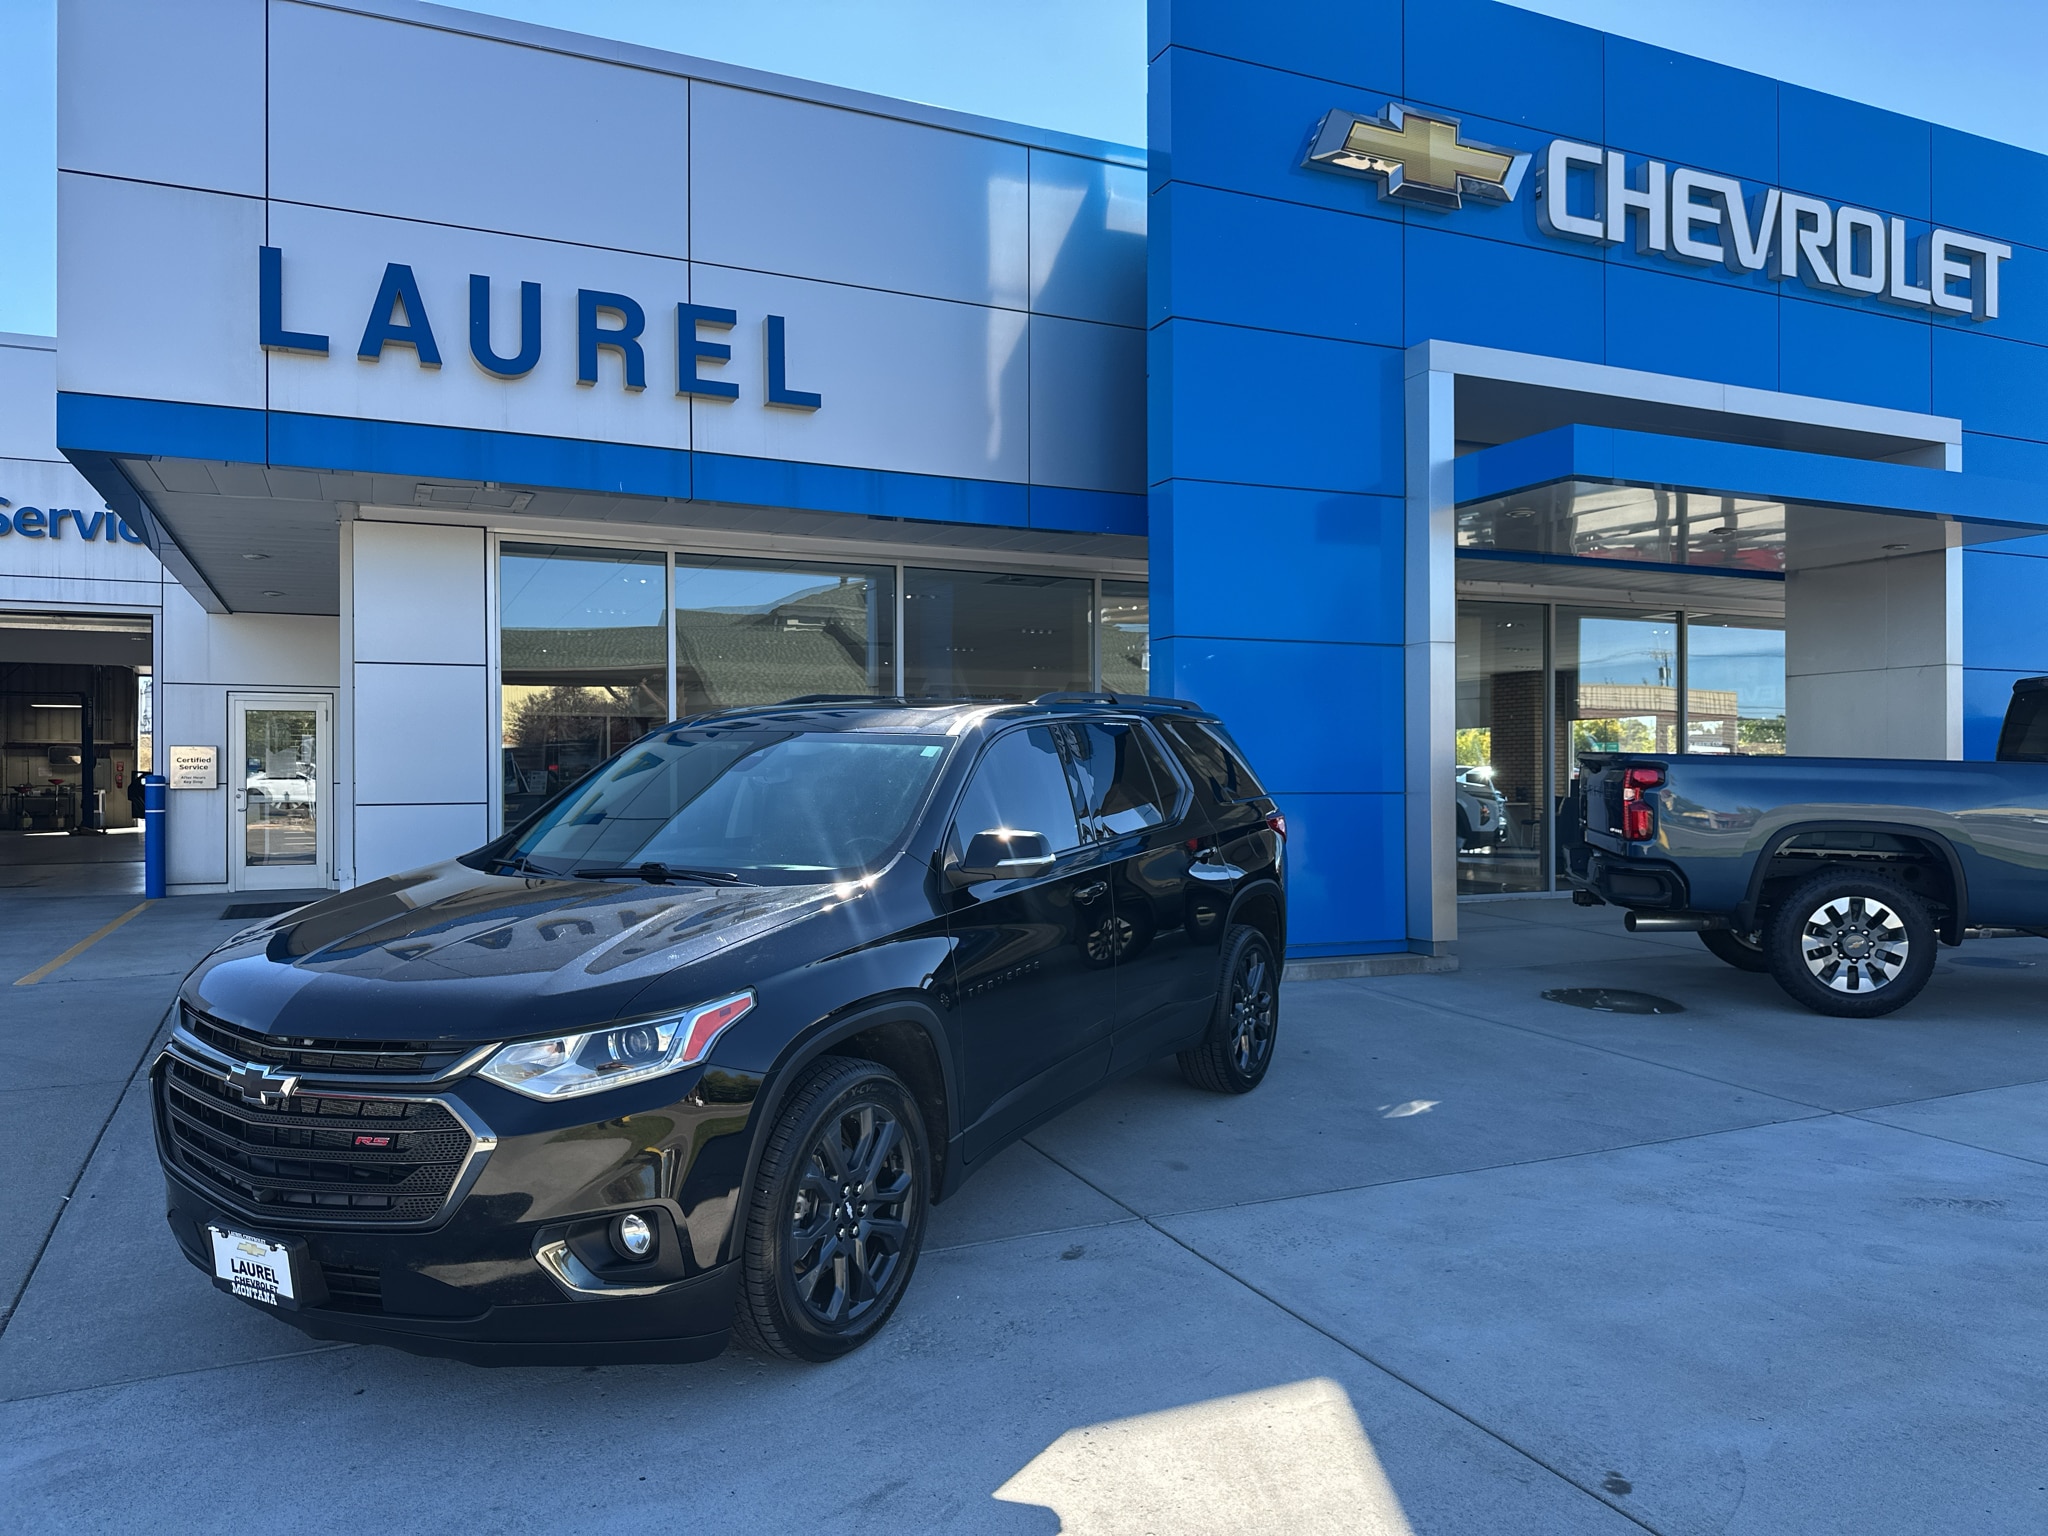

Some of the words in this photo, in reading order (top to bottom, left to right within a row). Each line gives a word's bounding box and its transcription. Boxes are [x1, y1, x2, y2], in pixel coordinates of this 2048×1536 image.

[1537, 138, 2012, 323] CHEVROLET
[259, 245, 822, 413] LAUREL
[967, 960, 1040, 997] TRAVERSE
[355, 1136, 390, 1146] RS
[230, 1258, 280, 1284] LAUREL
[231, 1281, 277, 1305] MONTANA
[234, 1275, 279, 1294] CHEVROLET
